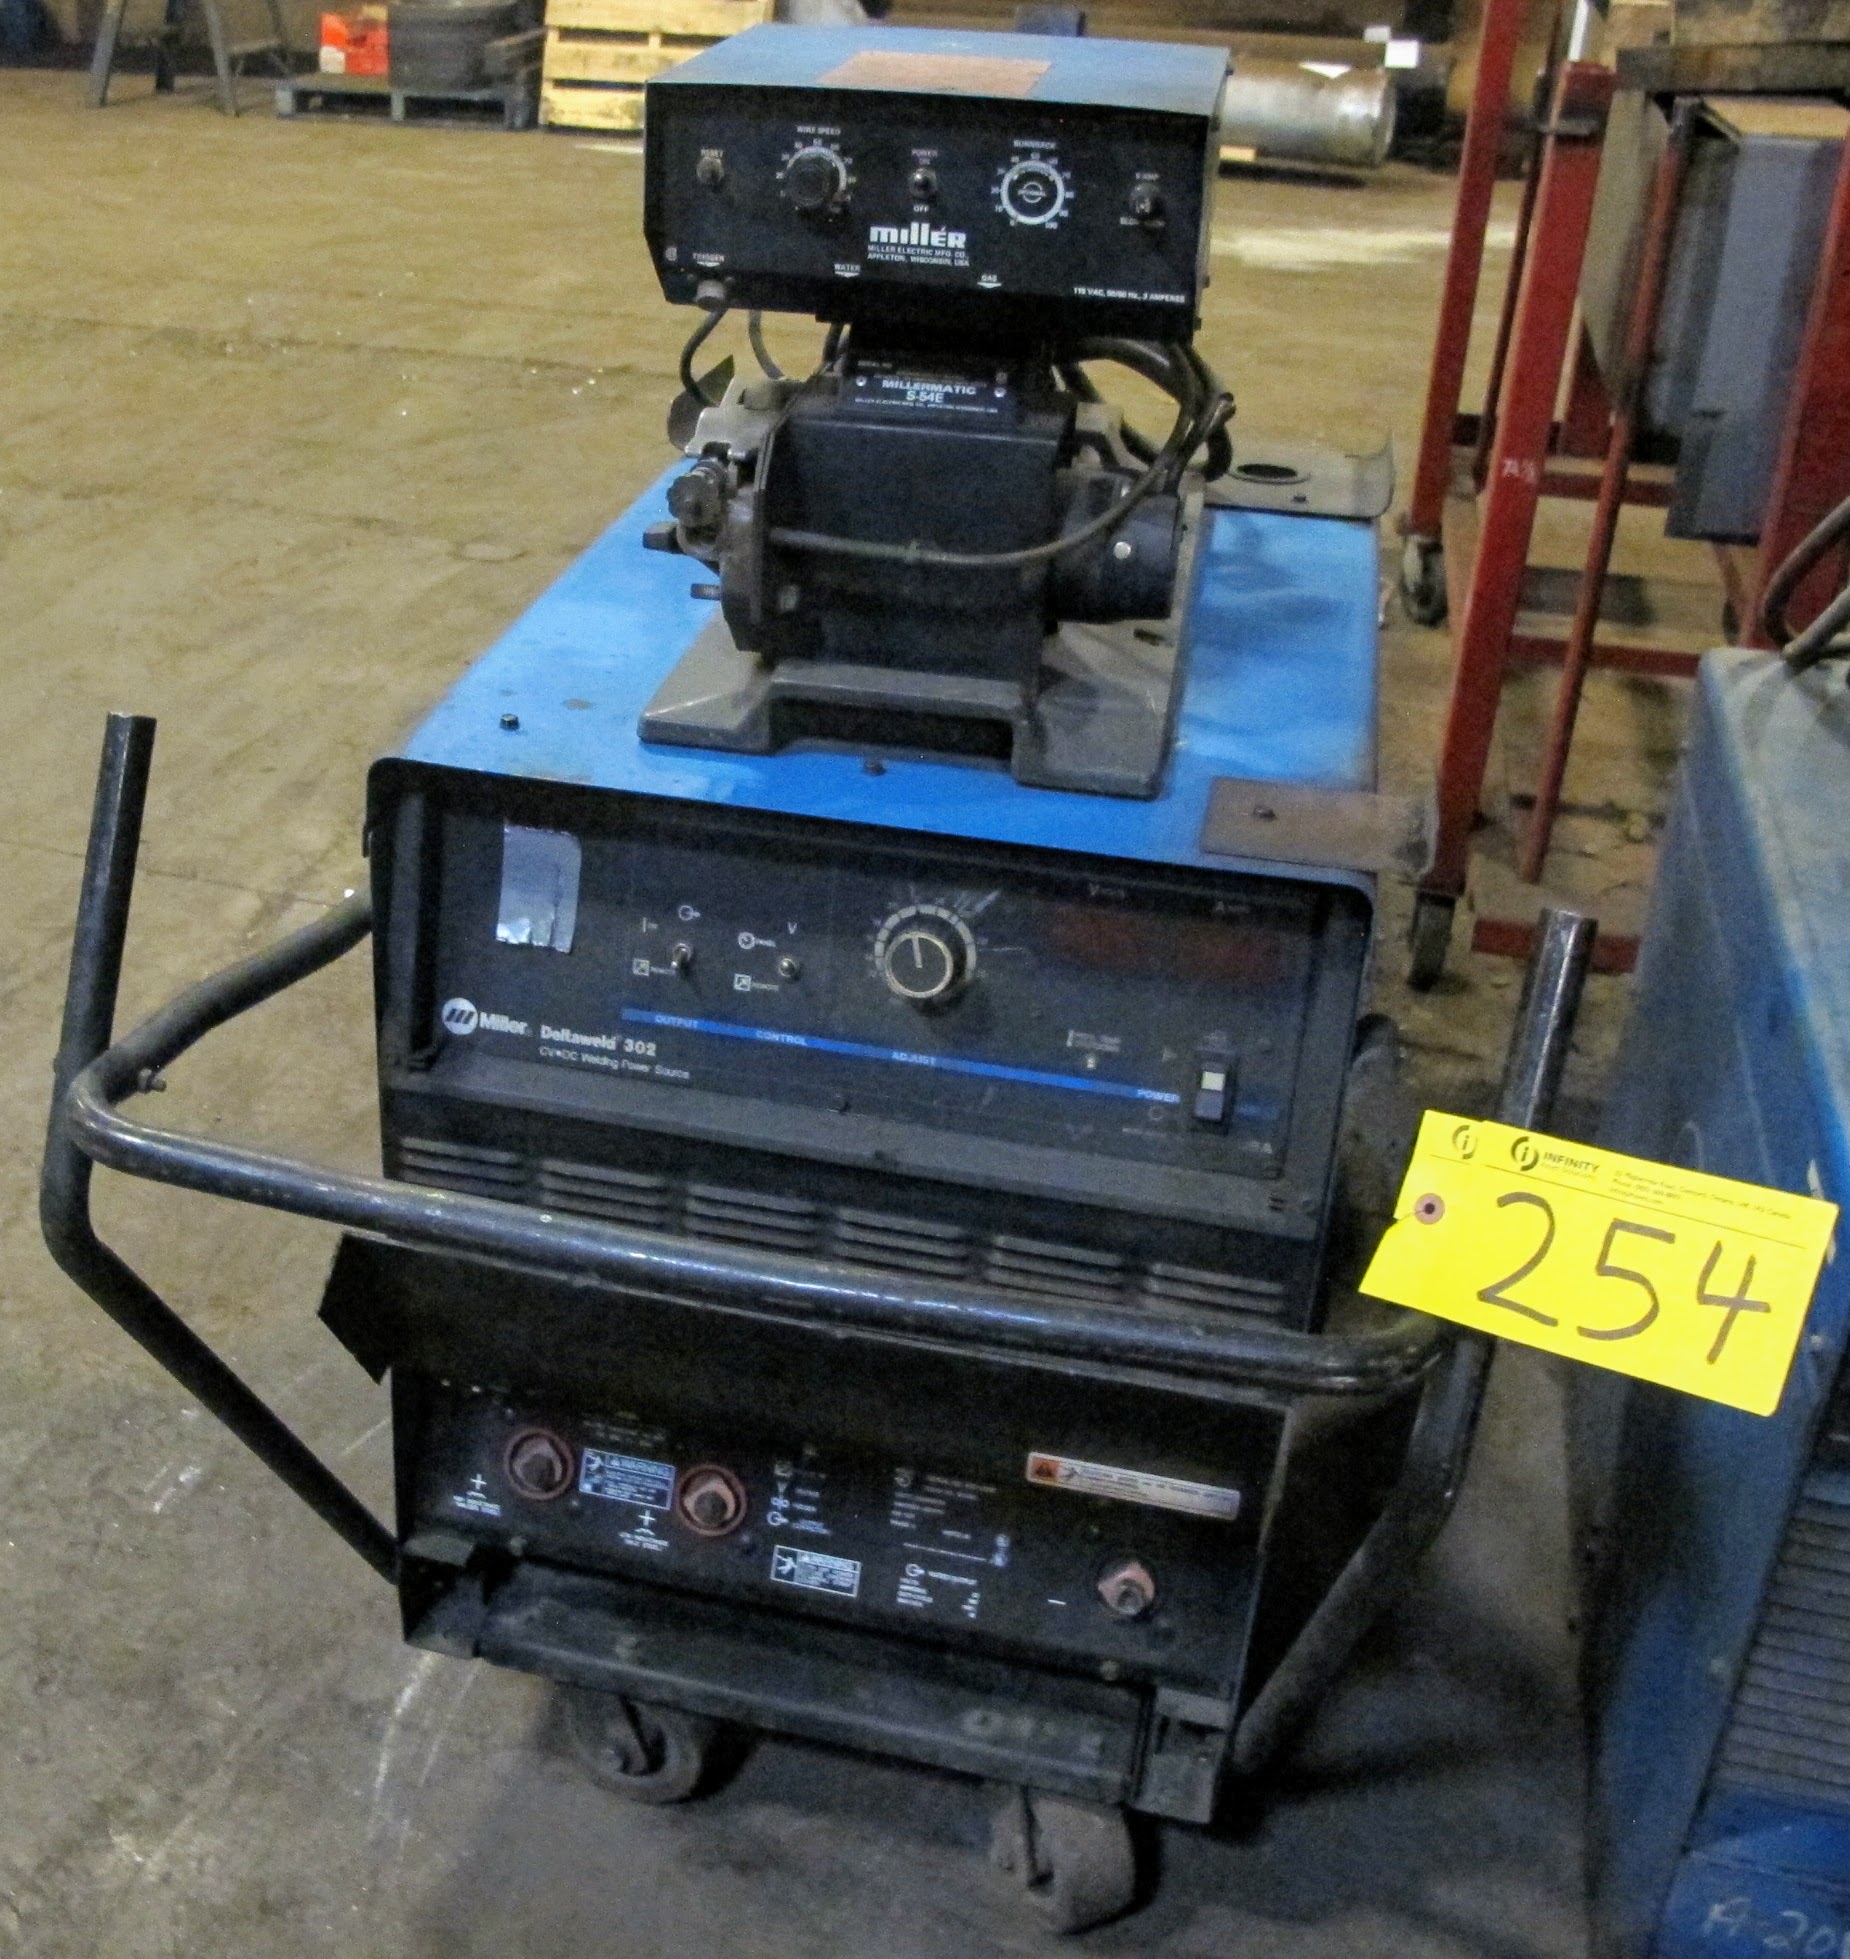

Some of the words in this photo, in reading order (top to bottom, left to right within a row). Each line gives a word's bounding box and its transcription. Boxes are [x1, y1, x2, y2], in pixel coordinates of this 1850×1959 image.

[818, 127, 841, 135] SPEED
[913, 204, 930, 212] OFF
[867, 244, 896, 253] MILLER
[897, 246, 933, 256] ELECTRIC
[834, 263, 861, 271] WATER
[954, 259, 970, 267] USA
[981, 274, 998, 282] GAS
[882, 379, 977, 395] MILLERMATIC
[905, 390, 945, 403] S-54E
[787, 921, 798, 935] V
[479, 1012, 528, 1036] Miller
[655, 1014, 699, 1029] OUTPUT
[540, 1024, 617, 1050] Deltaweld
[623, 1038, 657, 1057] 302
[755, 1029, 808, 1047] CONTROL
[581, 1052, 618, 1070] Welding
[621, 1060, 650, 1073] Power
[891, 1051, 937, 1066] ADJUST
[1136, 1088, 1181, 1104] POWER
[1543, 1151, 1600, 1173] INFINITY
[1476, 1191, 1772, 1366] 254
